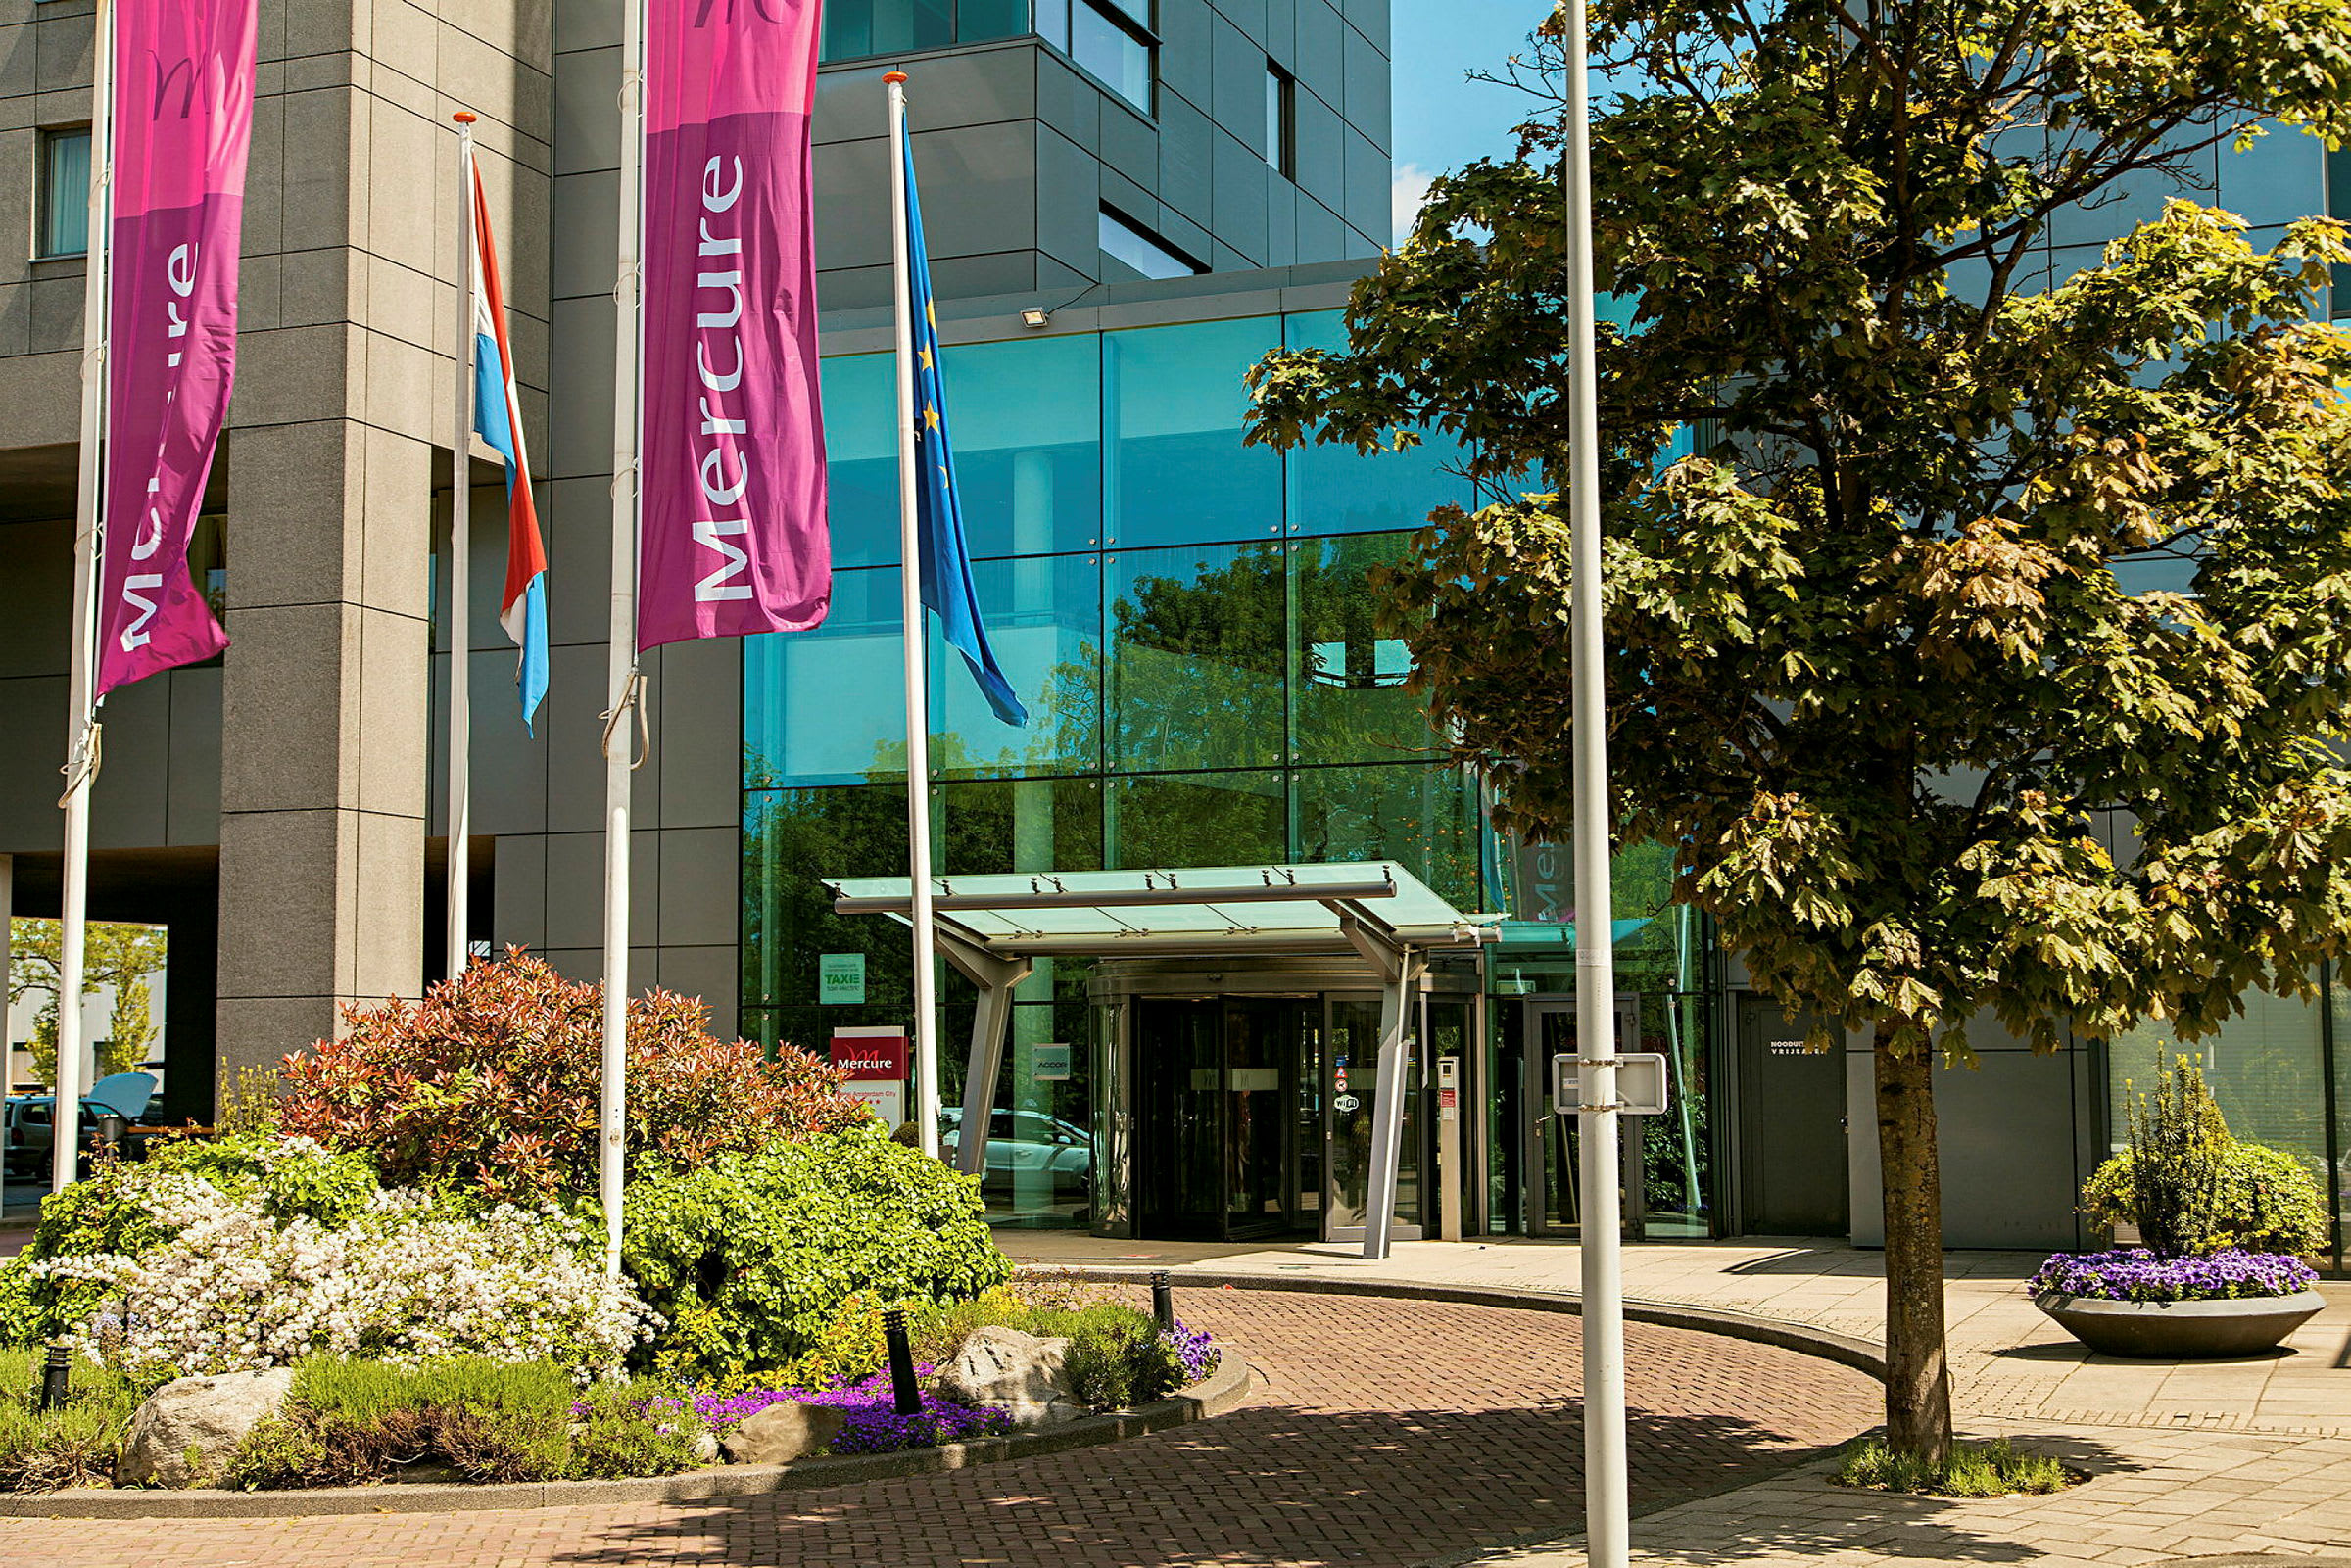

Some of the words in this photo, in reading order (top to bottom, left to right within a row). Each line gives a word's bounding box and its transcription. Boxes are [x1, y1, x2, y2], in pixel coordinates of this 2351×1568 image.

[120, 241, 199, 652] Mere
[692, 154, 752, 602] Mercure
[838, 1059, 892, 1069] Mercure
